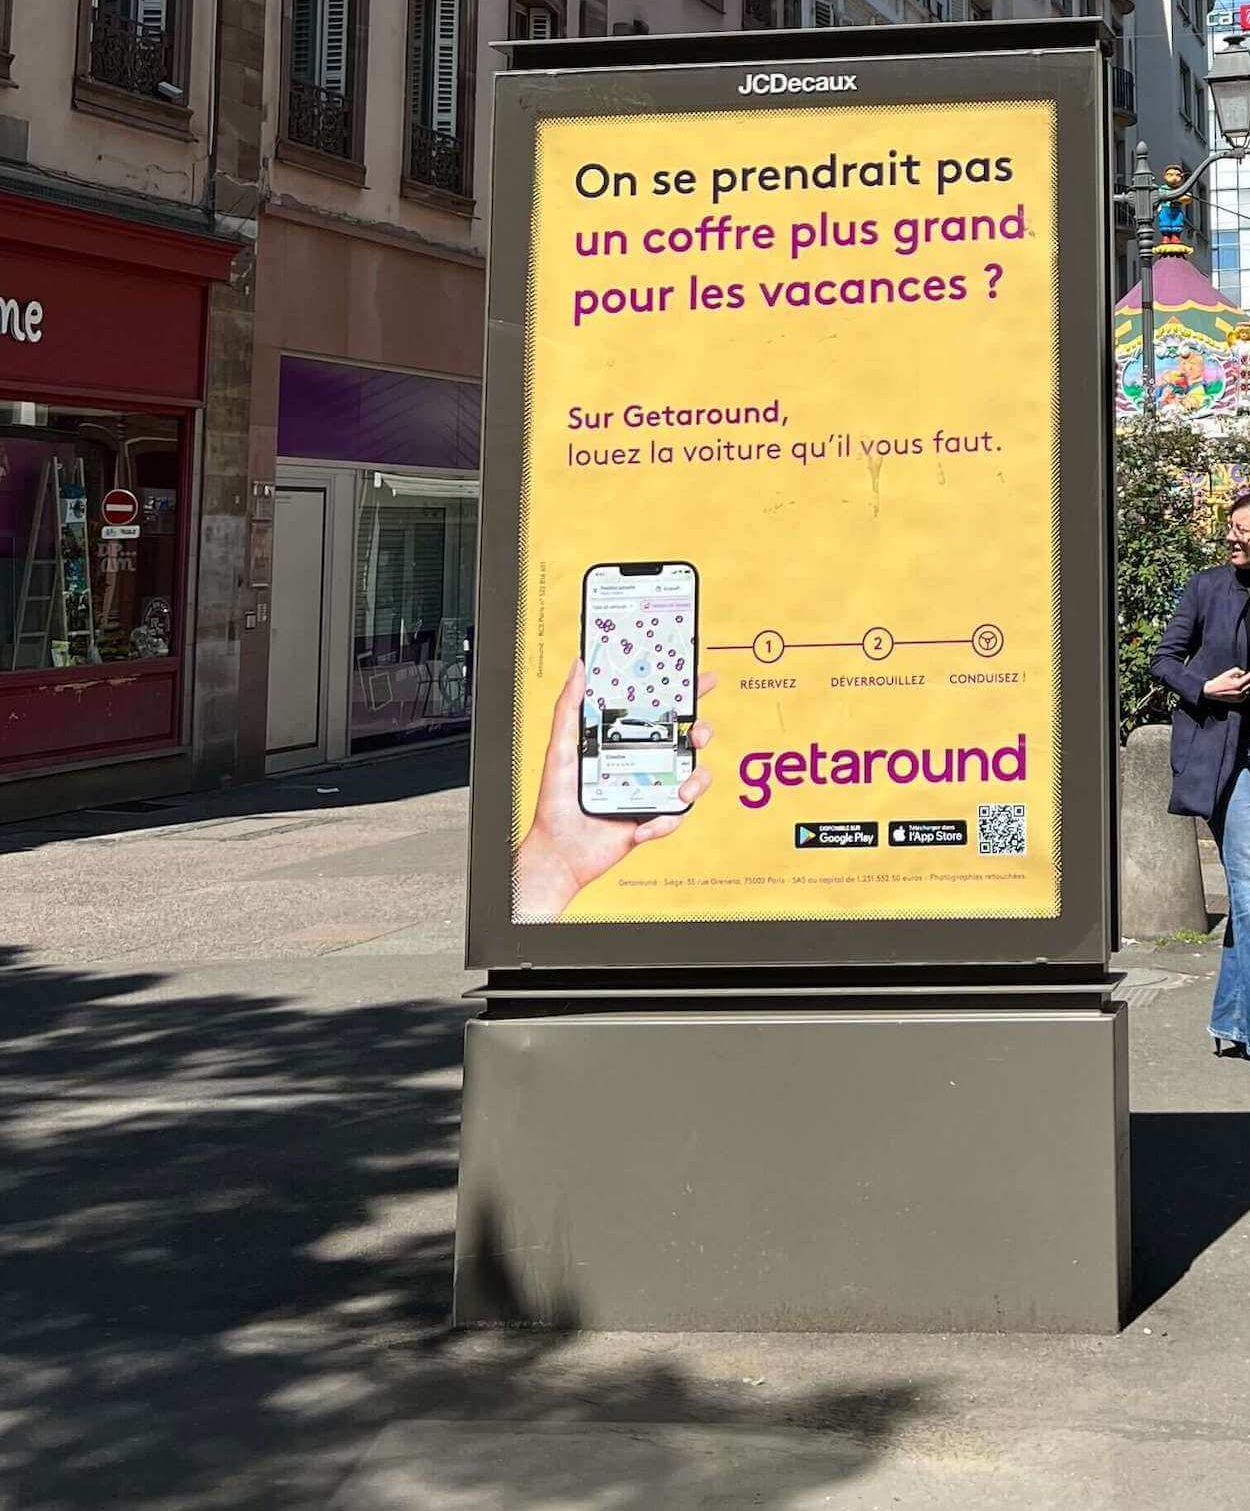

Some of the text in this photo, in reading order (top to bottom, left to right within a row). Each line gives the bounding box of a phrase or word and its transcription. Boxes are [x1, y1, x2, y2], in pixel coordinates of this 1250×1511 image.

[738, 74, 857, 94] JCDecaux
[576, 150, 1012, 204] On se prendrait pas
[576, 204, 1026, 259] un coffre plus grand
[574, 287, 674, 326] pour
[690, 275, 745, 310] les
[759, 275, 967, 307] vacances
[568, 400, 788, 429] Sur Getaround,
[569, 430, 1001, 466] louez la voiture qu'il vous faut.
[765, 636, 883, 654] 1 2
[741, 677, 796, 689] RÉSERVEZ
[831, 675, 925, 687] DÉVERROUILLEZ
[950, 673, 1018, 684] CONDUISEZ
[739, 733, 1027, 809] getaround
[819, 831, 875, 845] Google Play
[938, 831, 963, 842] Store
